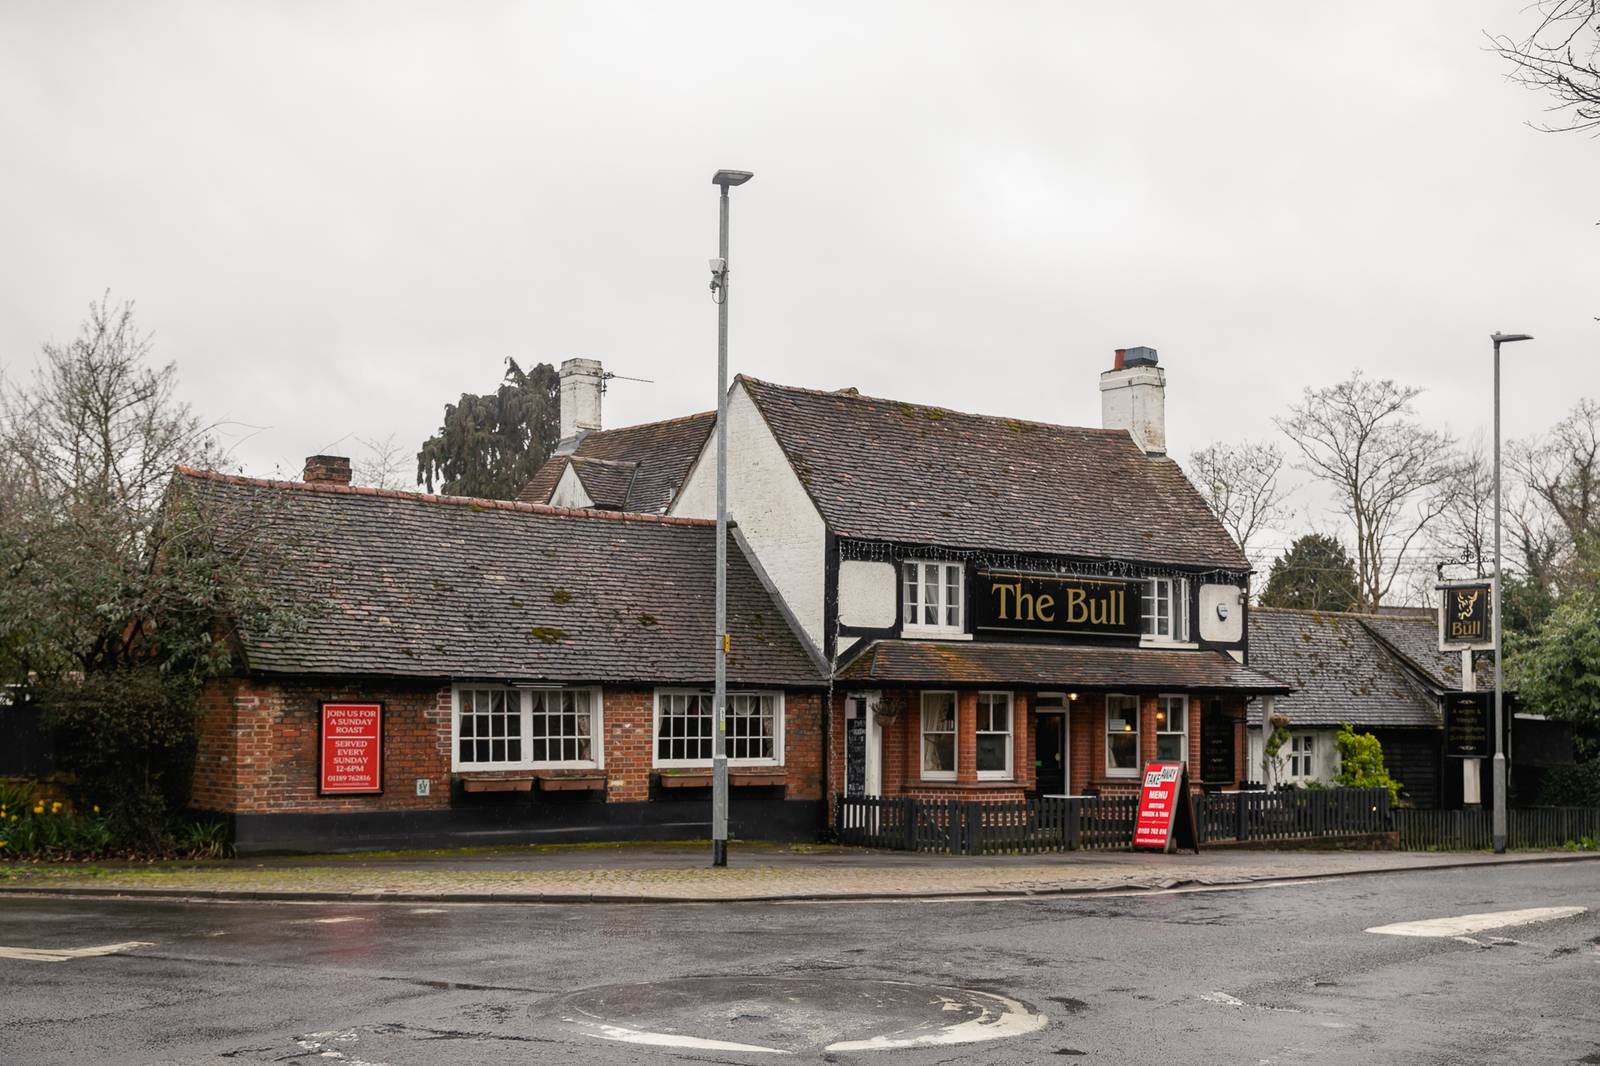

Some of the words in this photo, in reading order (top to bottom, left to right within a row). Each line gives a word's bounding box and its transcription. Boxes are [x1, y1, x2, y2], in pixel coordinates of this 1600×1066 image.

[992, 583, 1055, 622] The
[1066, 588, 1126, 625] Bull
[1452, 621, 1480, 635] Bull
[327, 710, 345, 718] JOIN
[1147, 773, 1160, 785] TAKE
[1161, 768, 1177, 780] AWAY
[1149, 790, 1168, 799] MENU
